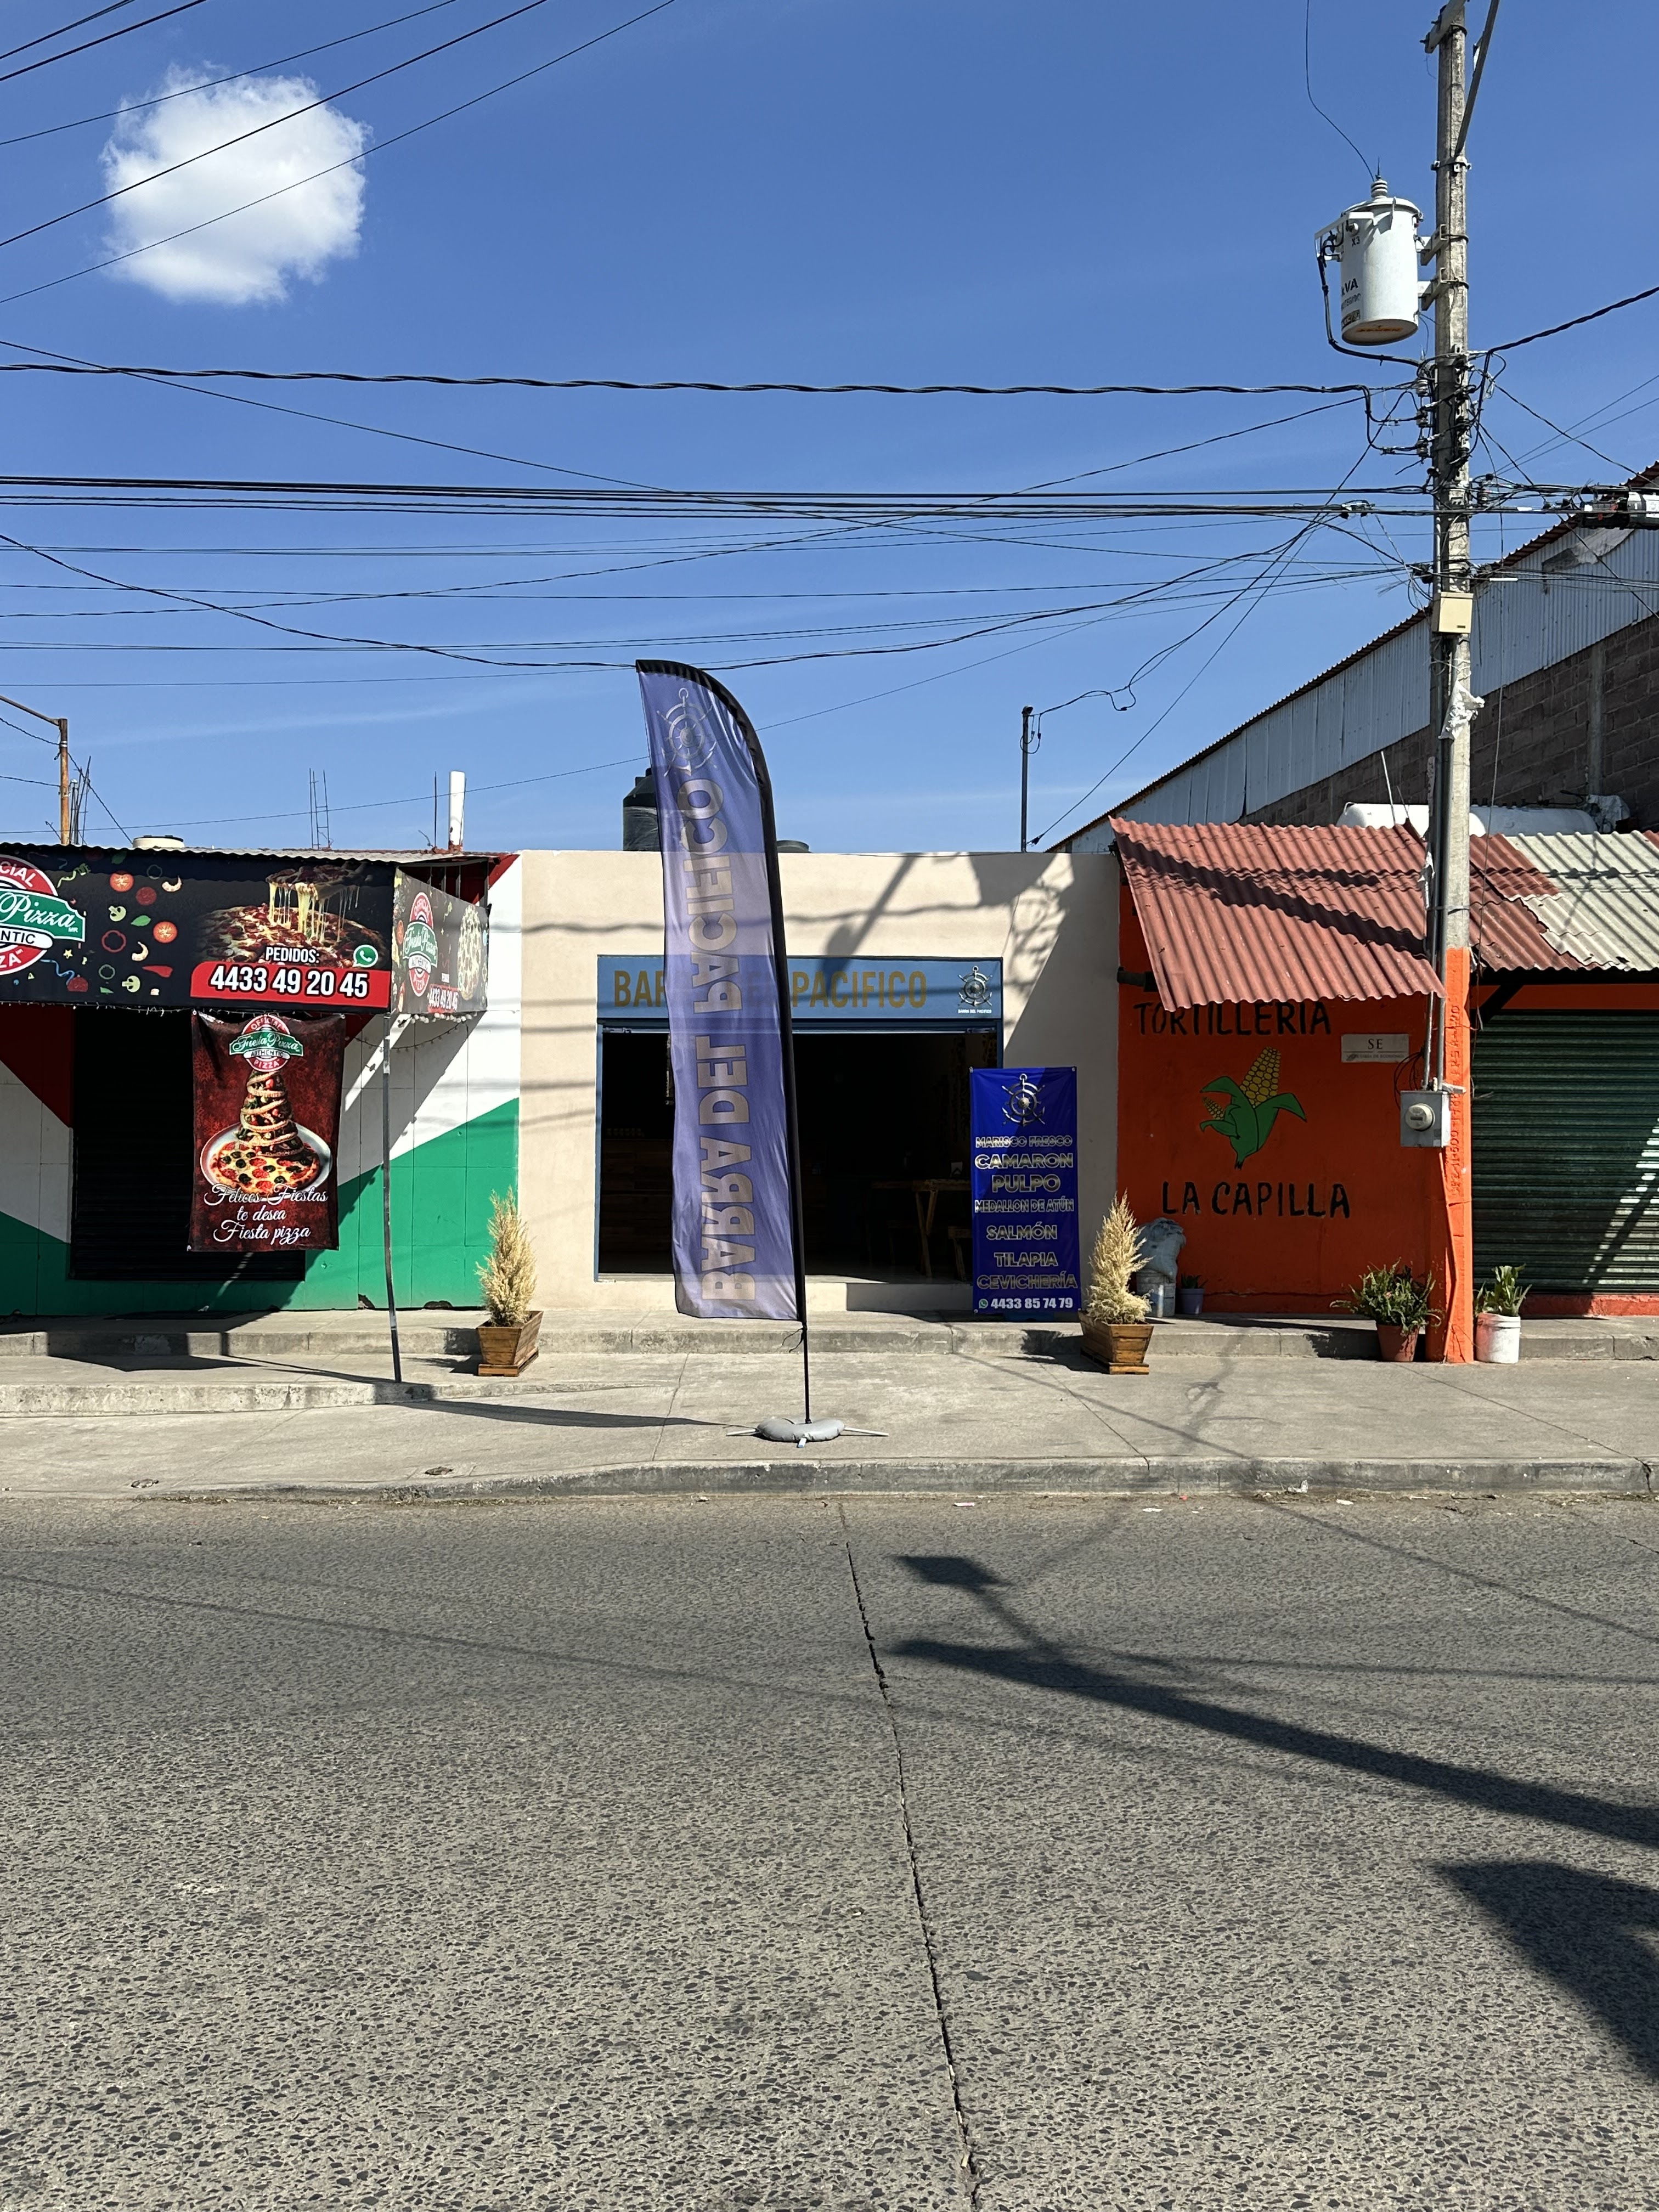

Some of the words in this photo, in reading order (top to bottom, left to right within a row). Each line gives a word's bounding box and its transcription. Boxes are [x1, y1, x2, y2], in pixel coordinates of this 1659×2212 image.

[0, 893, 76, 928] Pizza
[1, 930, 36, 944] NTIC
[266, 946, 320, 963] PEDIDOS:
[211, 966, 267, 991] 4433
[272, 969, 301, 994] 49
[307, 971, 335, 996] 20
[340, 973, 368, 997] 45
[792, 970, 927, 1008] PACIFICO
[251, 1017, 284, 1030] OFFICIAL
[1133, 1001, 1331, 1036] TORTILLERIA
[233, 1035, 267, 1052] Fiesta
[267, 1032, 299, 1051] Pizza
[1368, 1038, 1383, 1050] SE
[253, 1059, 280, 1069] PIZZA
[975, 1136, 1027, 1148] MARISCO
[1029, 1135, 1073, 1147] FRESCO
[975, 1153, 1074, 1169] CAMARON
[992, 1173, 1061, 1193] PULPO
[204, 1183, 262, 1206] Felices
[267, 1183, 328, 1205] Fiestas
[1162, 1181, 1201, 1216] LA
[1211, 1182, 1350, 1218] CAPILLA
[236, 1205, 249, 1221] te
[252, 1205, 287, 1221] desea
[974, 1199, 1029, 1213] MEDALLON
[1030, 1199, 1045, 1212] DE
[1046, 1195, 1074, 1212] ATÚN
[213, 1220, 270, 1242] Fiesta
[270, 1227, 311, 1245] pizza
[986, 1221, 1058, 1240] SALMÓN
[994, 1252, 1058, 1267] TILAPIA
[977, 1270, 1078, 1289] CEVICHERÍA
[991, 1298, 1022, 1309] 4433
[1024, 1298, 1041, 1309] 85
[1042, 1297, 1057, 1308] 74
[1058, 1297, 1073, 1308] 79
